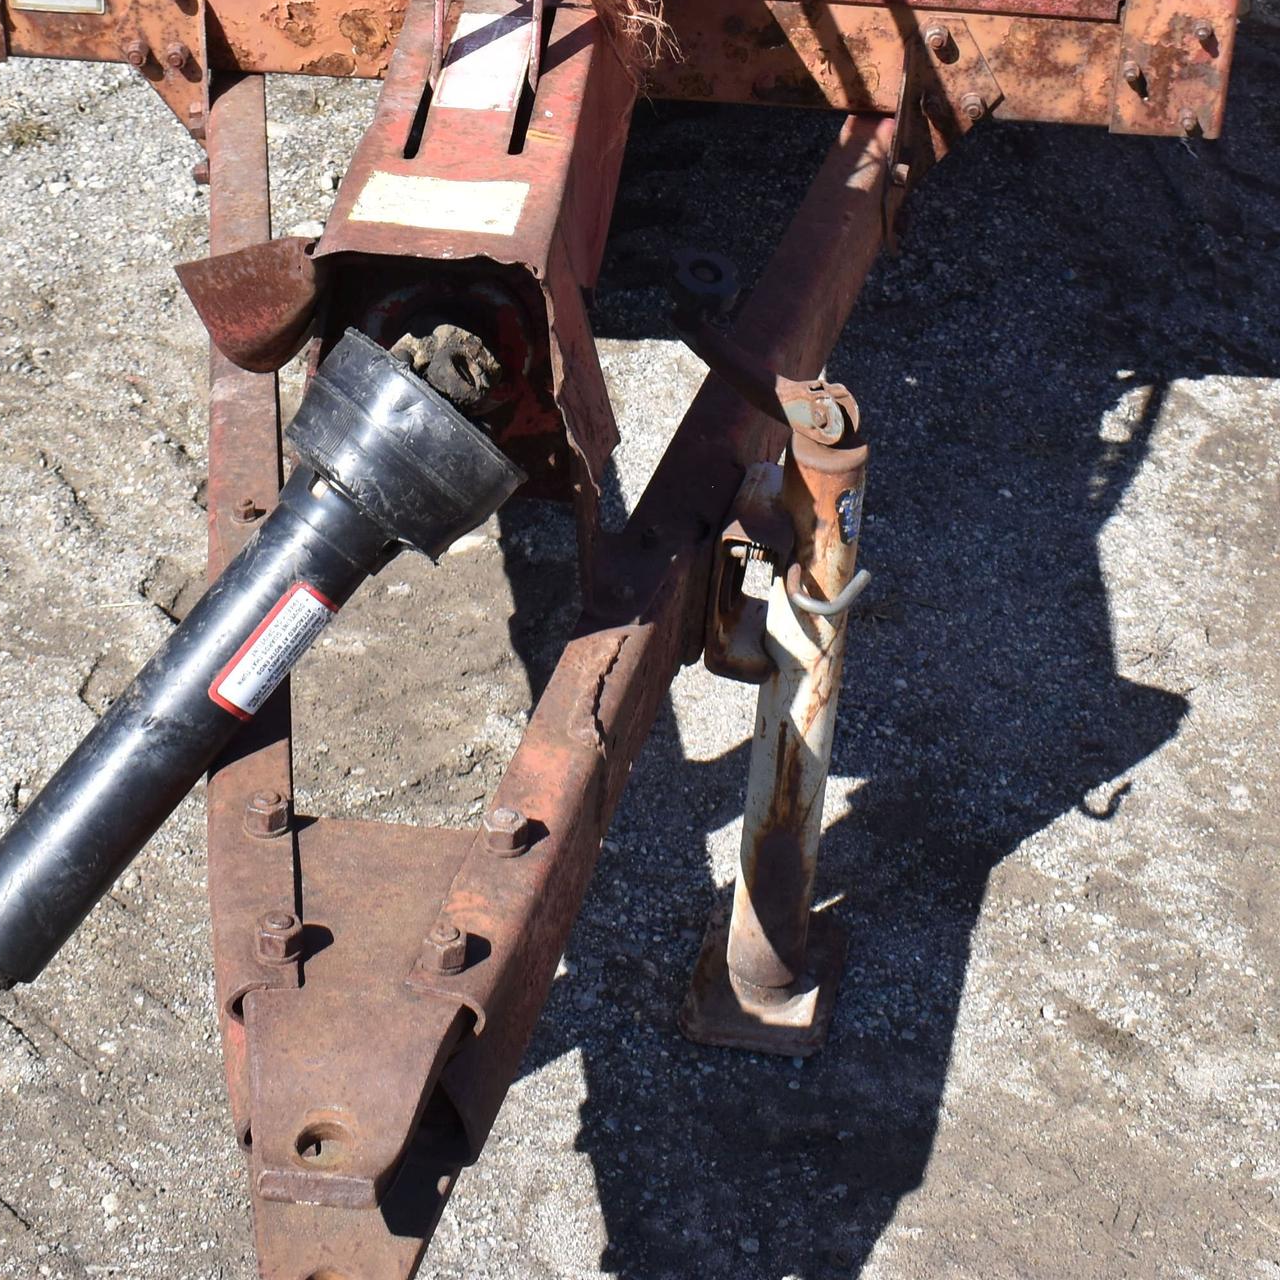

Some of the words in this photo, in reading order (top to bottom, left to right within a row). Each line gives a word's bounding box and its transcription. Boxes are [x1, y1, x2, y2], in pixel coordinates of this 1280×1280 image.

[286, 607, 312, 637] ATTACHED
[280, 635, 289, 645] AT
[268, 644, 282, 660] BOTH
[255, 659, 270, 676] ENDS
